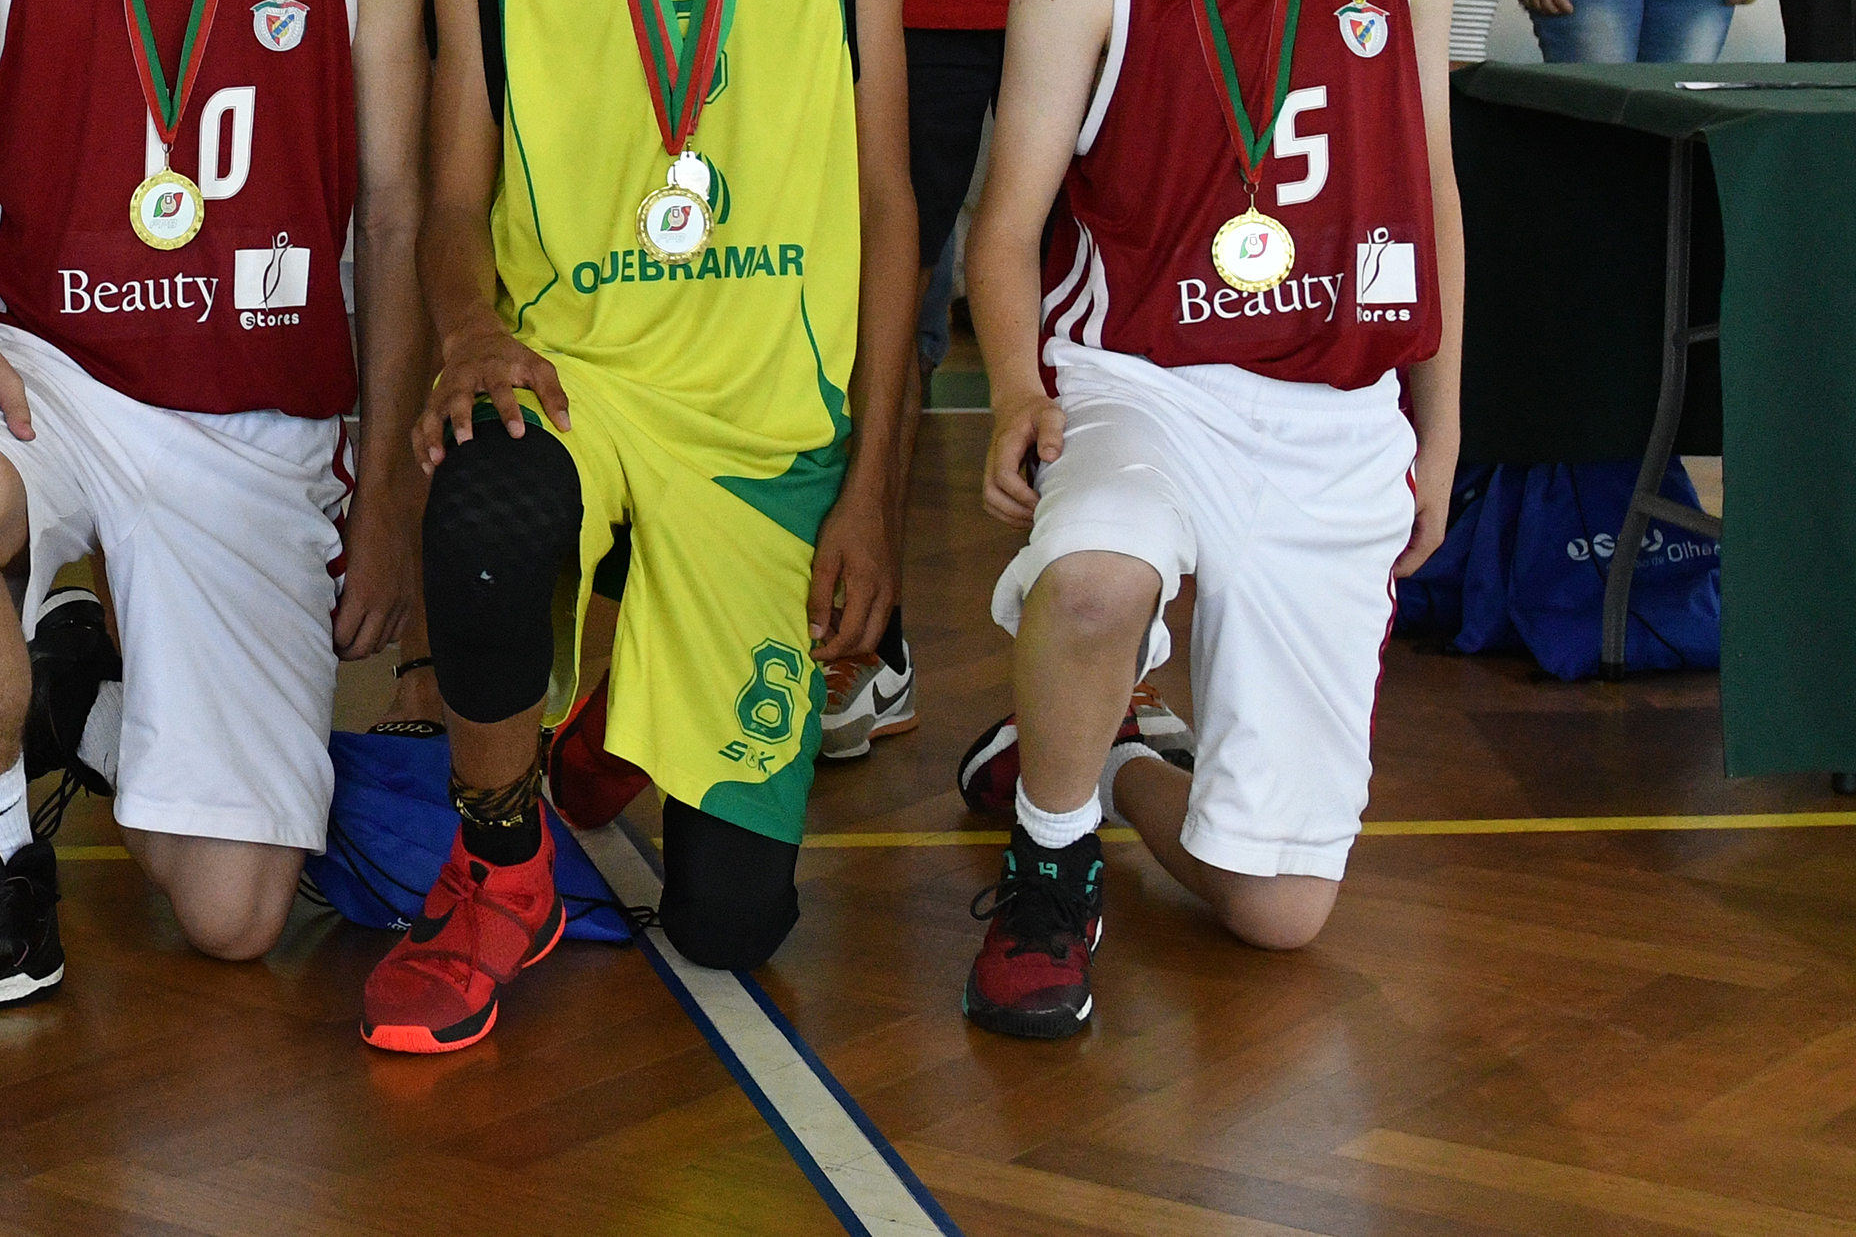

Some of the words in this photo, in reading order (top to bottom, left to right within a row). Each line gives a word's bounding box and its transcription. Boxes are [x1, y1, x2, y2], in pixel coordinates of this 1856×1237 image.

[1273, 86, 1328, 206] 5
[57, 269, 219, 323] Beauty
[1177, 271, 1345, 325] Beauty
[734, 637, 804, 745] 6
